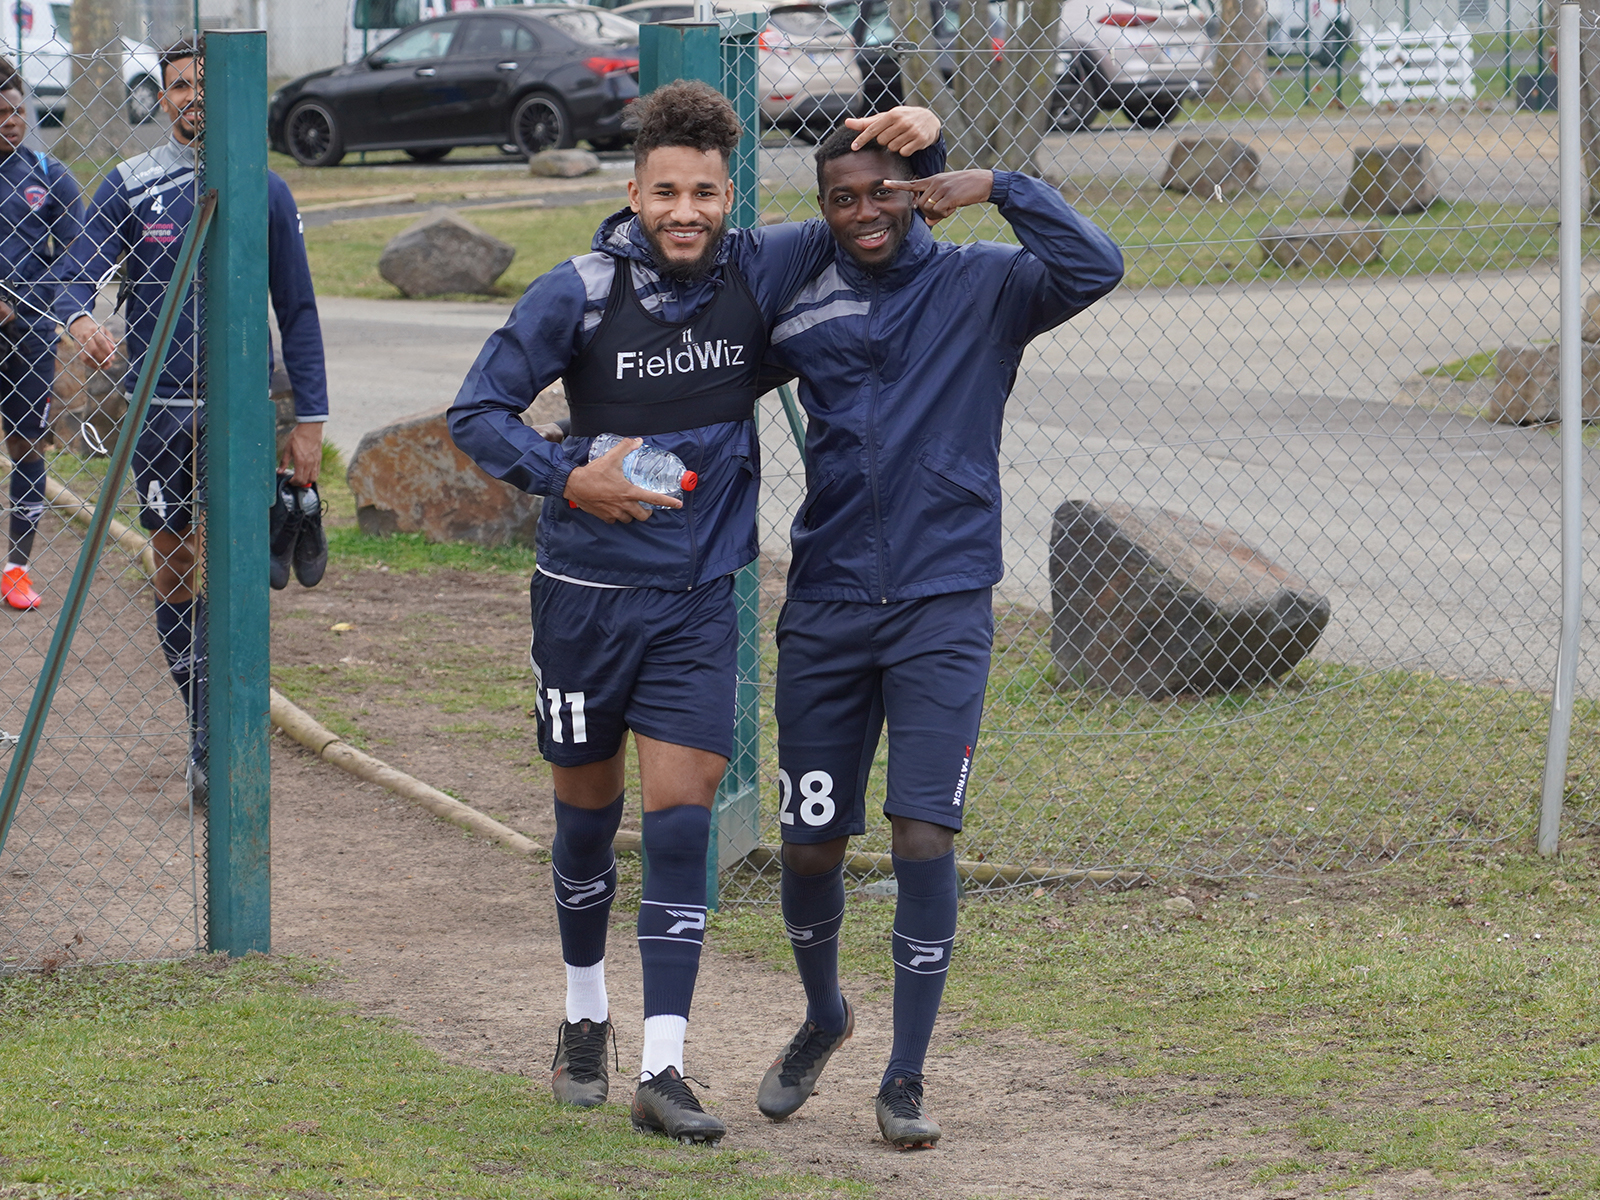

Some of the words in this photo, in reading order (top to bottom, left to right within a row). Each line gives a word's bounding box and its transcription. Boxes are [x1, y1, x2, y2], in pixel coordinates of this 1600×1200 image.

[150, 194, 164, 215] 4
[682, 328, 693, 343] 11
[616, 339, 745, 380] FieldWiz
[147, 480, 167, 518] 4
[546, 688, 587, 744] 11
[779, 767, 836, 826] 28
[952, 757, 970, 806] PATRICK
